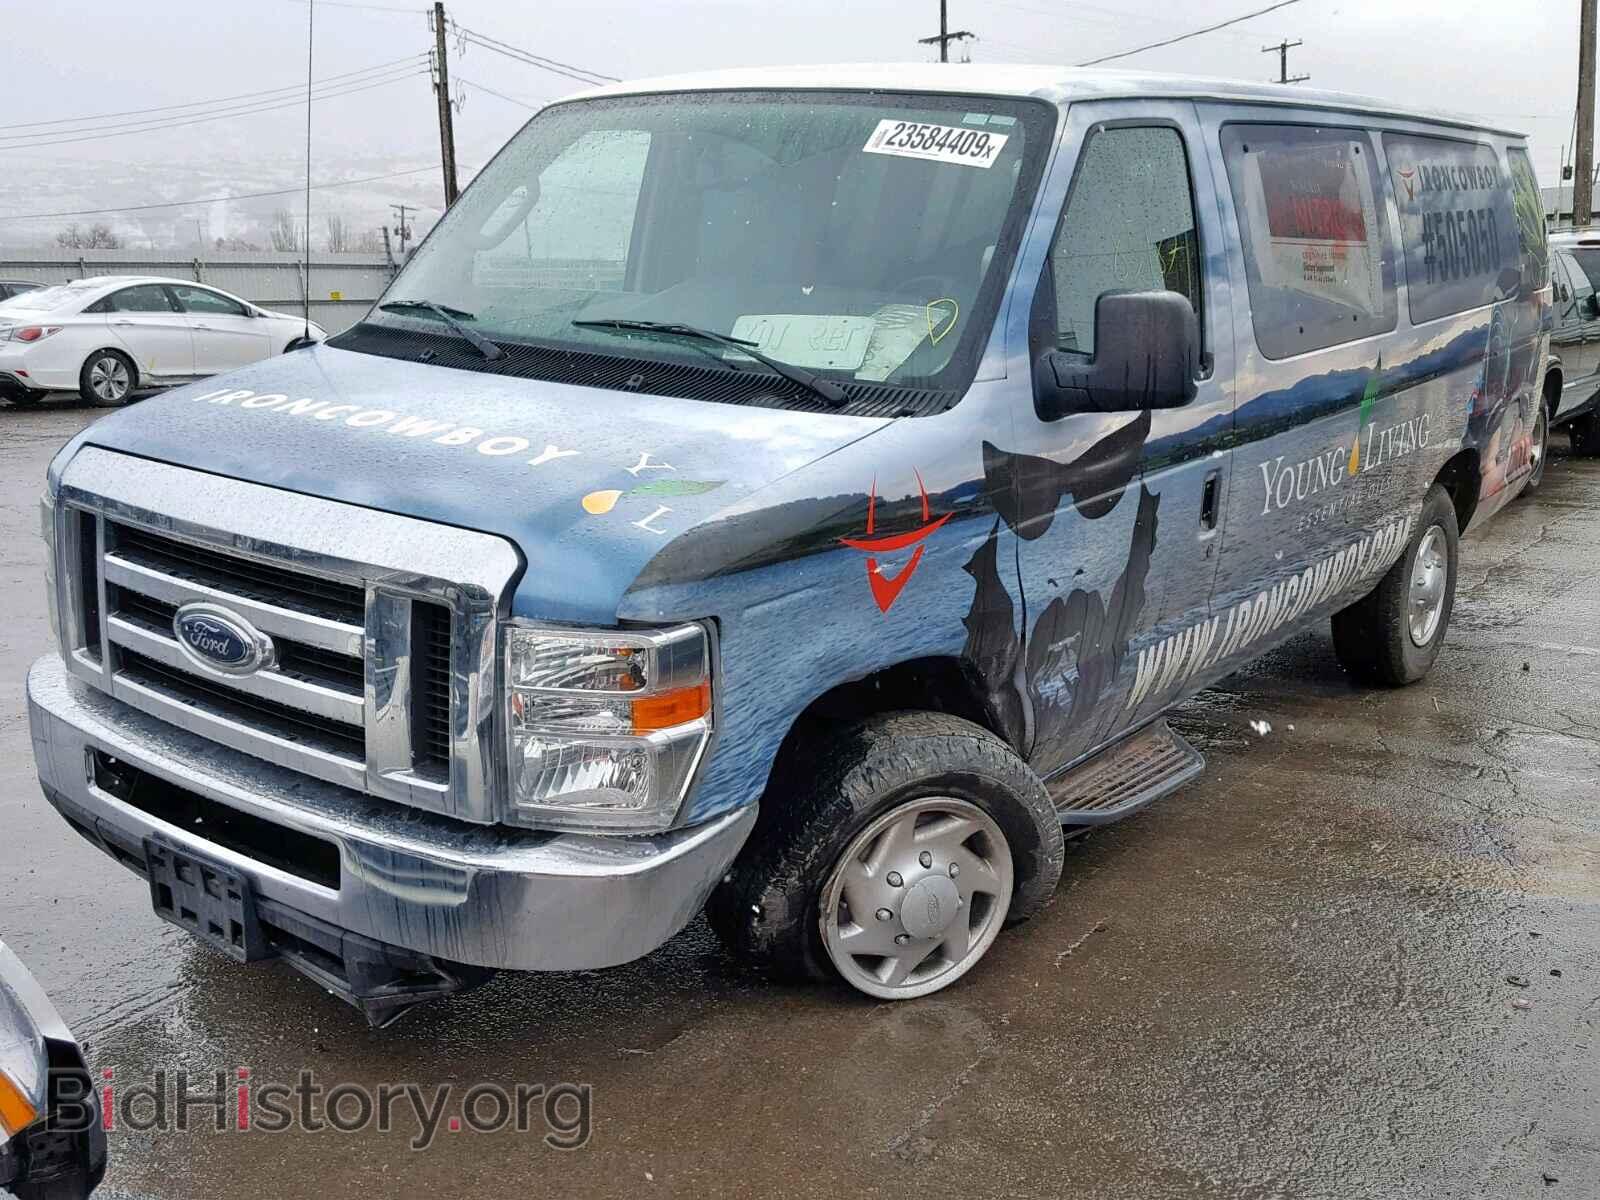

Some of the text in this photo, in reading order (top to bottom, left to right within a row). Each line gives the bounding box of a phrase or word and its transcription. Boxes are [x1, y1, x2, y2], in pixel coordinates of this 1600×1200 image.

[1417, 165, 1501, 193] IRONCOWBOY
[1422, 207, 1500, 284] #505050
[192, 388, 581, 466] IRONCOWBOY
[190, 621, 231, 656] Ford
